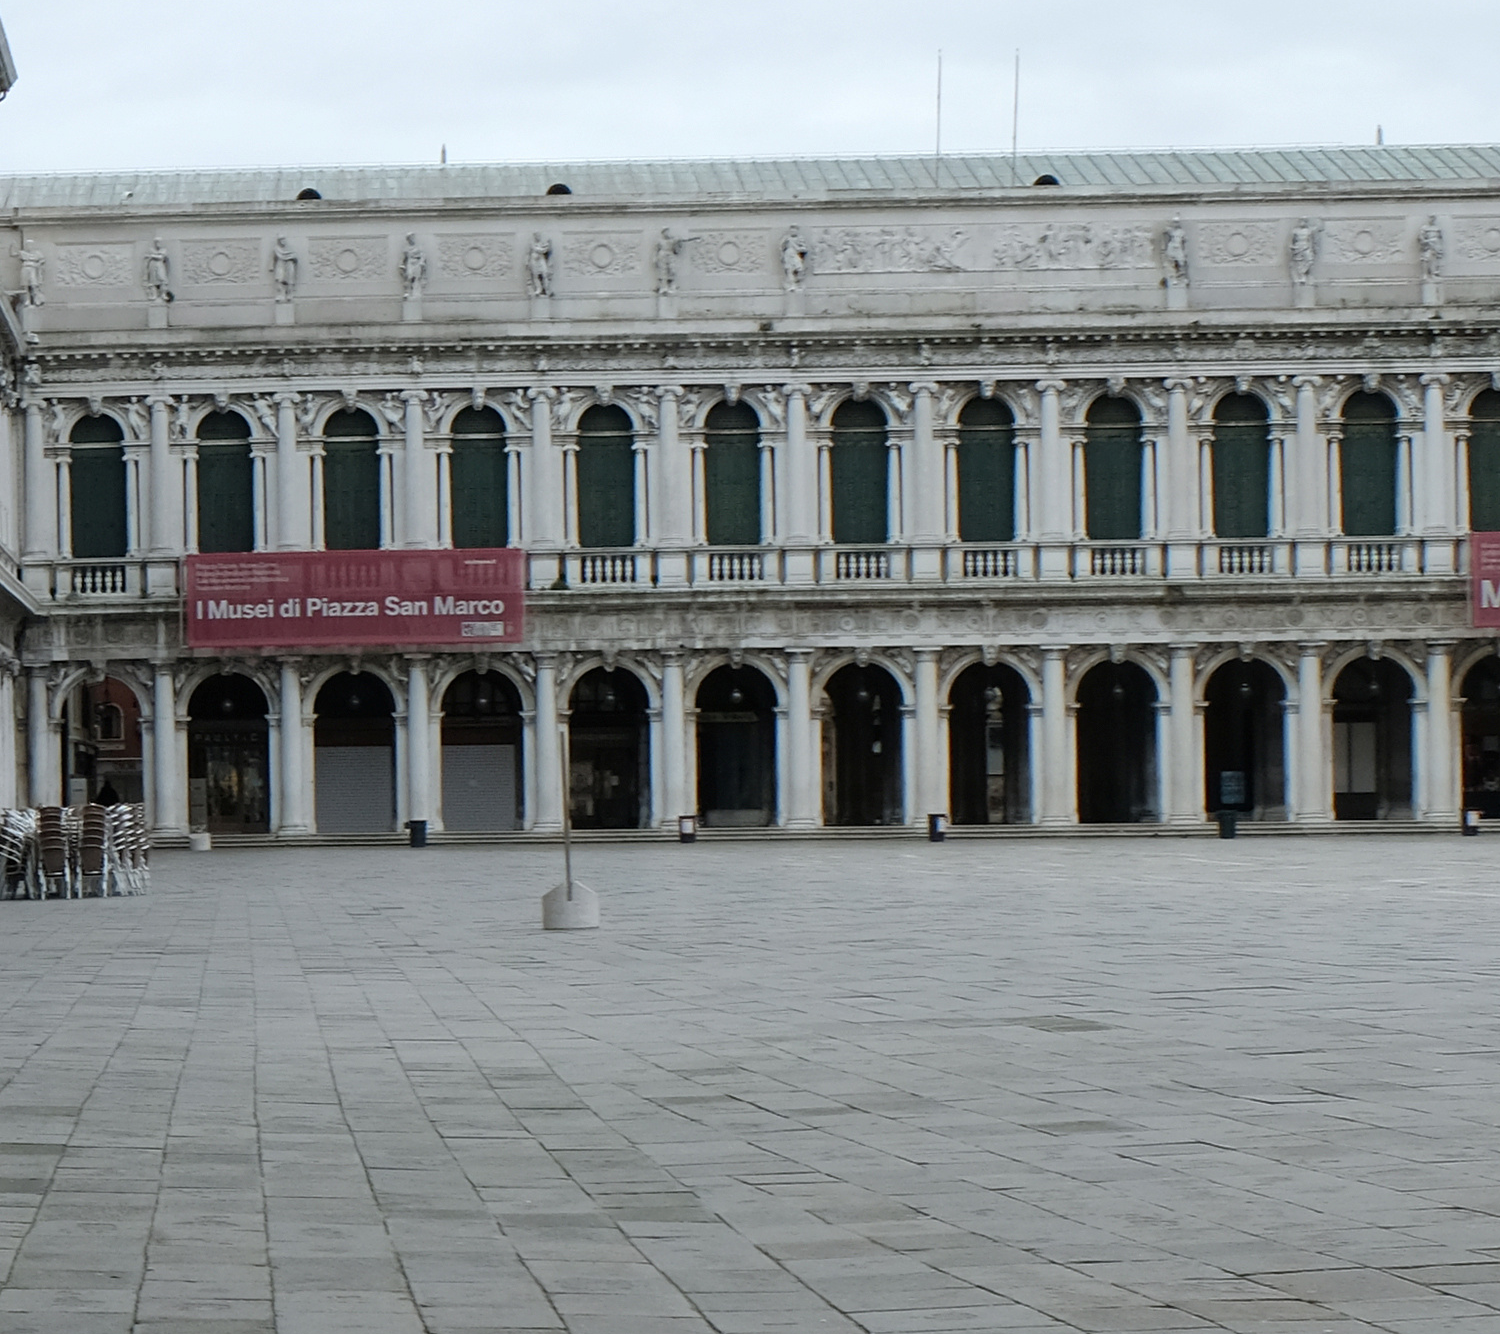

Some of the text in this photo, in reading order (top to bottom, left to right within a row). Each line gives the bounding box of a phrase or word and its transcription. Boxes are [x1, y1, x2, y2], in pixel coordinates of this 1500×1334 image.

[197, 596, 505, 620] I Musei di Piazza San Marco
